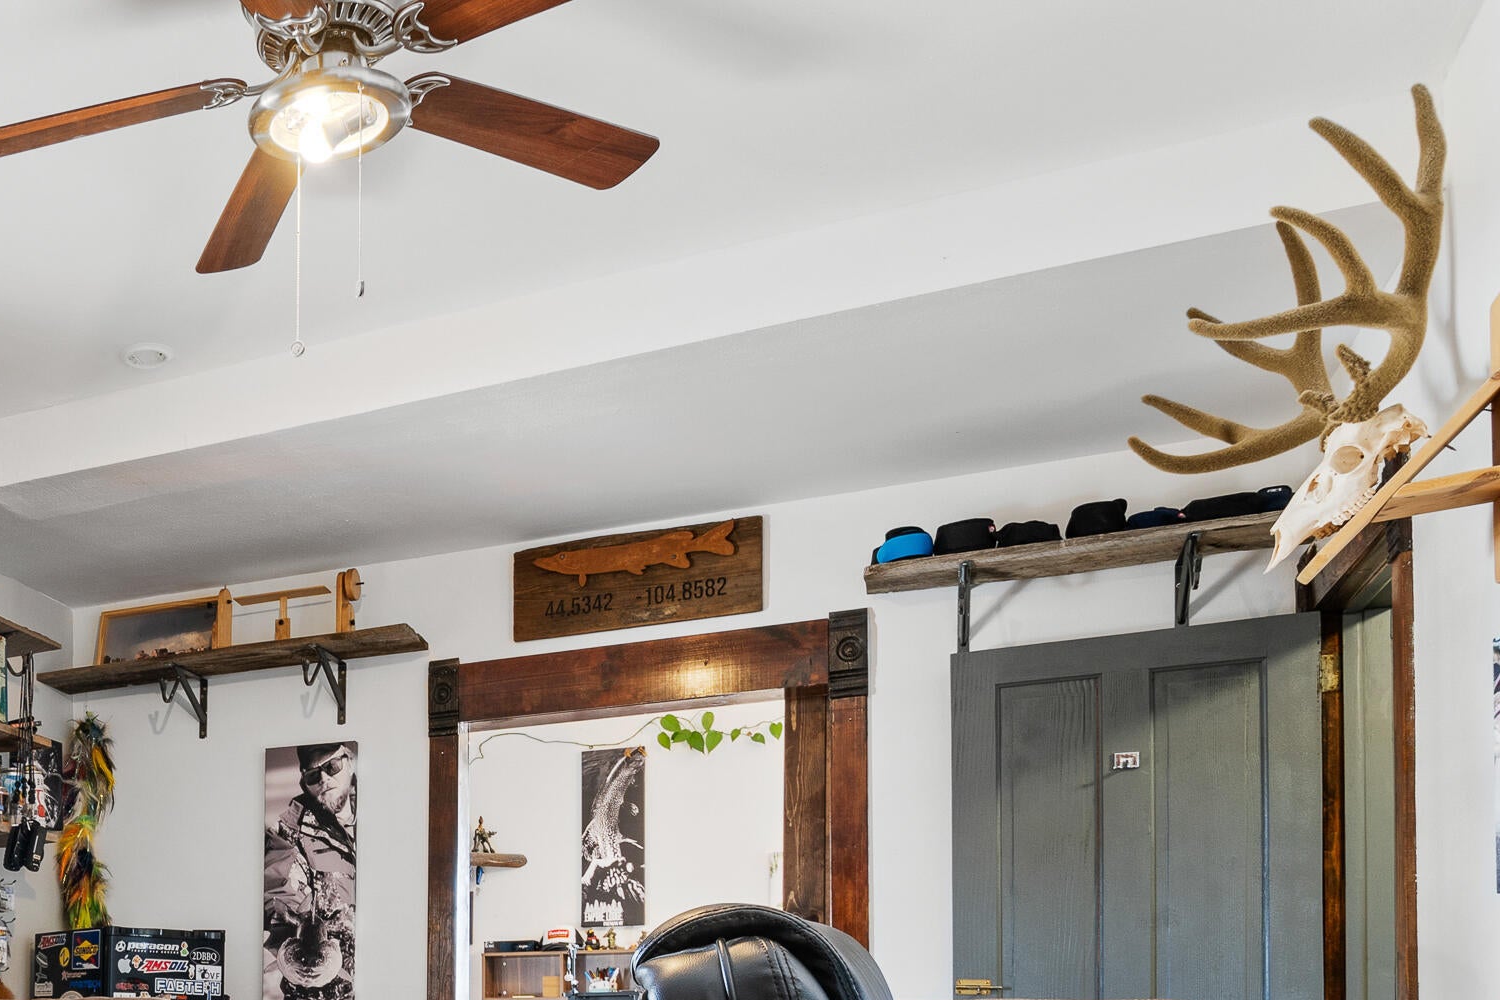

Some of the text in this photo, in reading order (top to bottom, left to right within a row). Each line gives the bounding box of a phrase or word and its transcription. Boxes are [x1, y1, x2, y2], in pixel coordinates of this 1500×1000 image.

[544, 576, 728, 619] 44.5342 -104.8582
[75, 945, 98, 955] SUNOCO
[192, 951, 218, 962] 2DBBQ
[141, 960, 188, 972] AMSOIL
